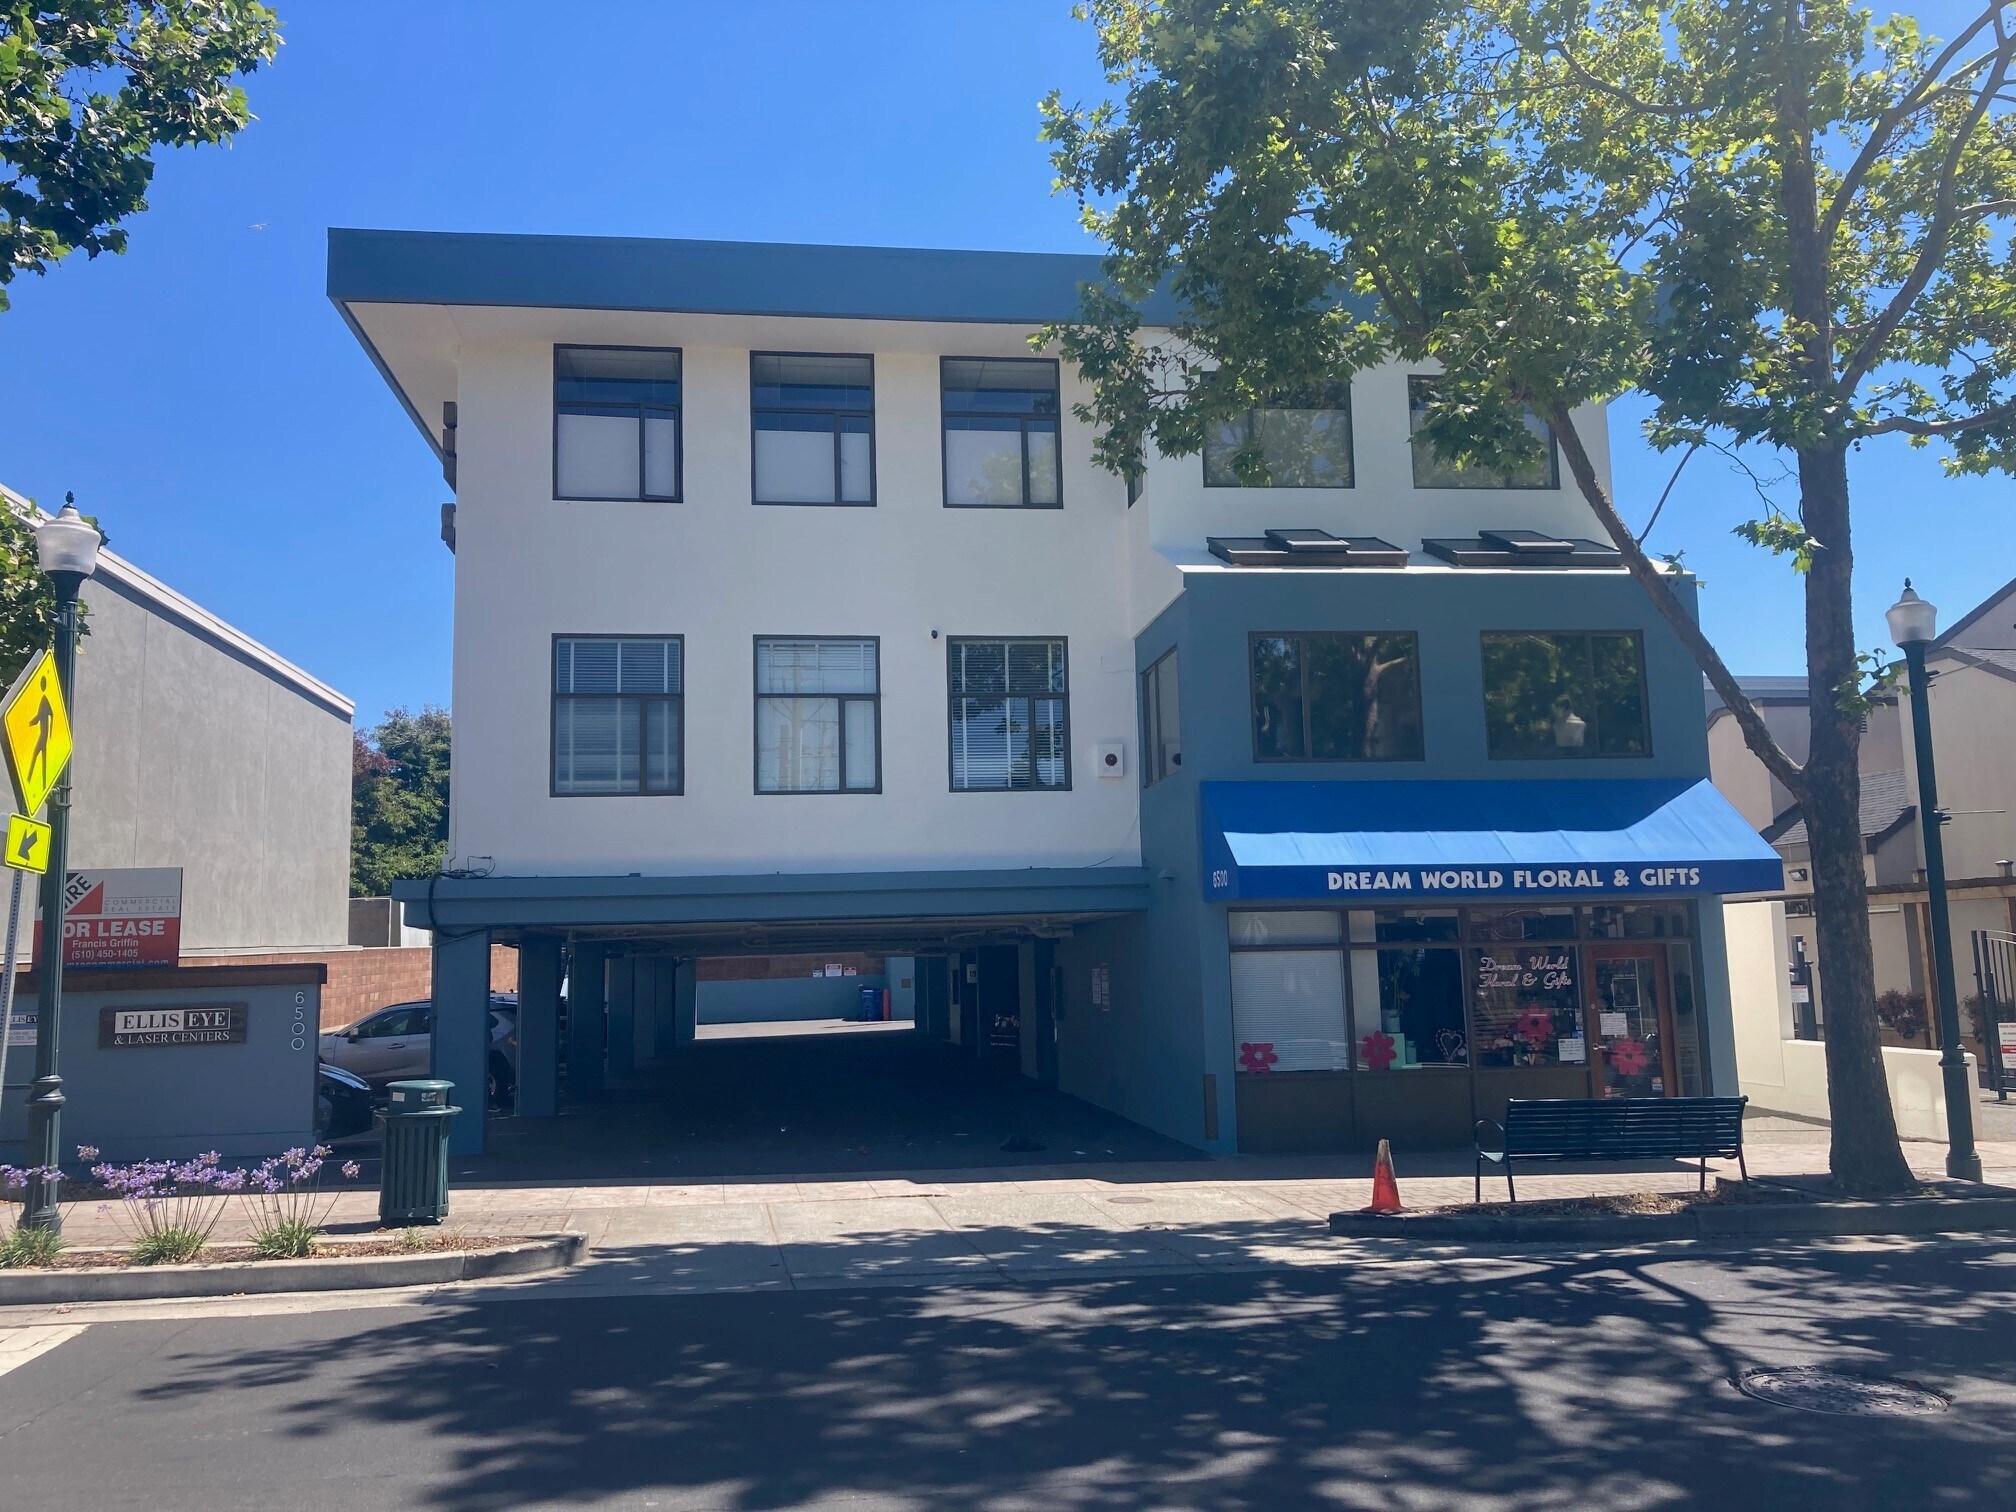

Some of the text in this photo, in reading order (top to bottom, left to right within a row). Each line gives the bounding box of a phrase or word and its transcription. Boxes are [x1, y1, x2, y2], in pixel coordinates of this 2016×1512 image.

[1328, 867, 1701, 890] DREAM WORLD FLORAL & GIFTS
[104, 898, 179, 906] COMMERCIAL
[104, 904, 177, 913] REAL ESTATE
[64, 920, 165, 938] OR LEASE
[72, 938, 139, 949] Francis Griffin
[71, 948, 139, 961] (510) 450-1405
[1478, 956, 1569, 972] Dream World
[1478, 971, 1571, 989] Floral & Gifts
[123, 1011, 226, 1030] ELLIS EYE
[114, 1030, 230, 1046] & LASER CENTERS
